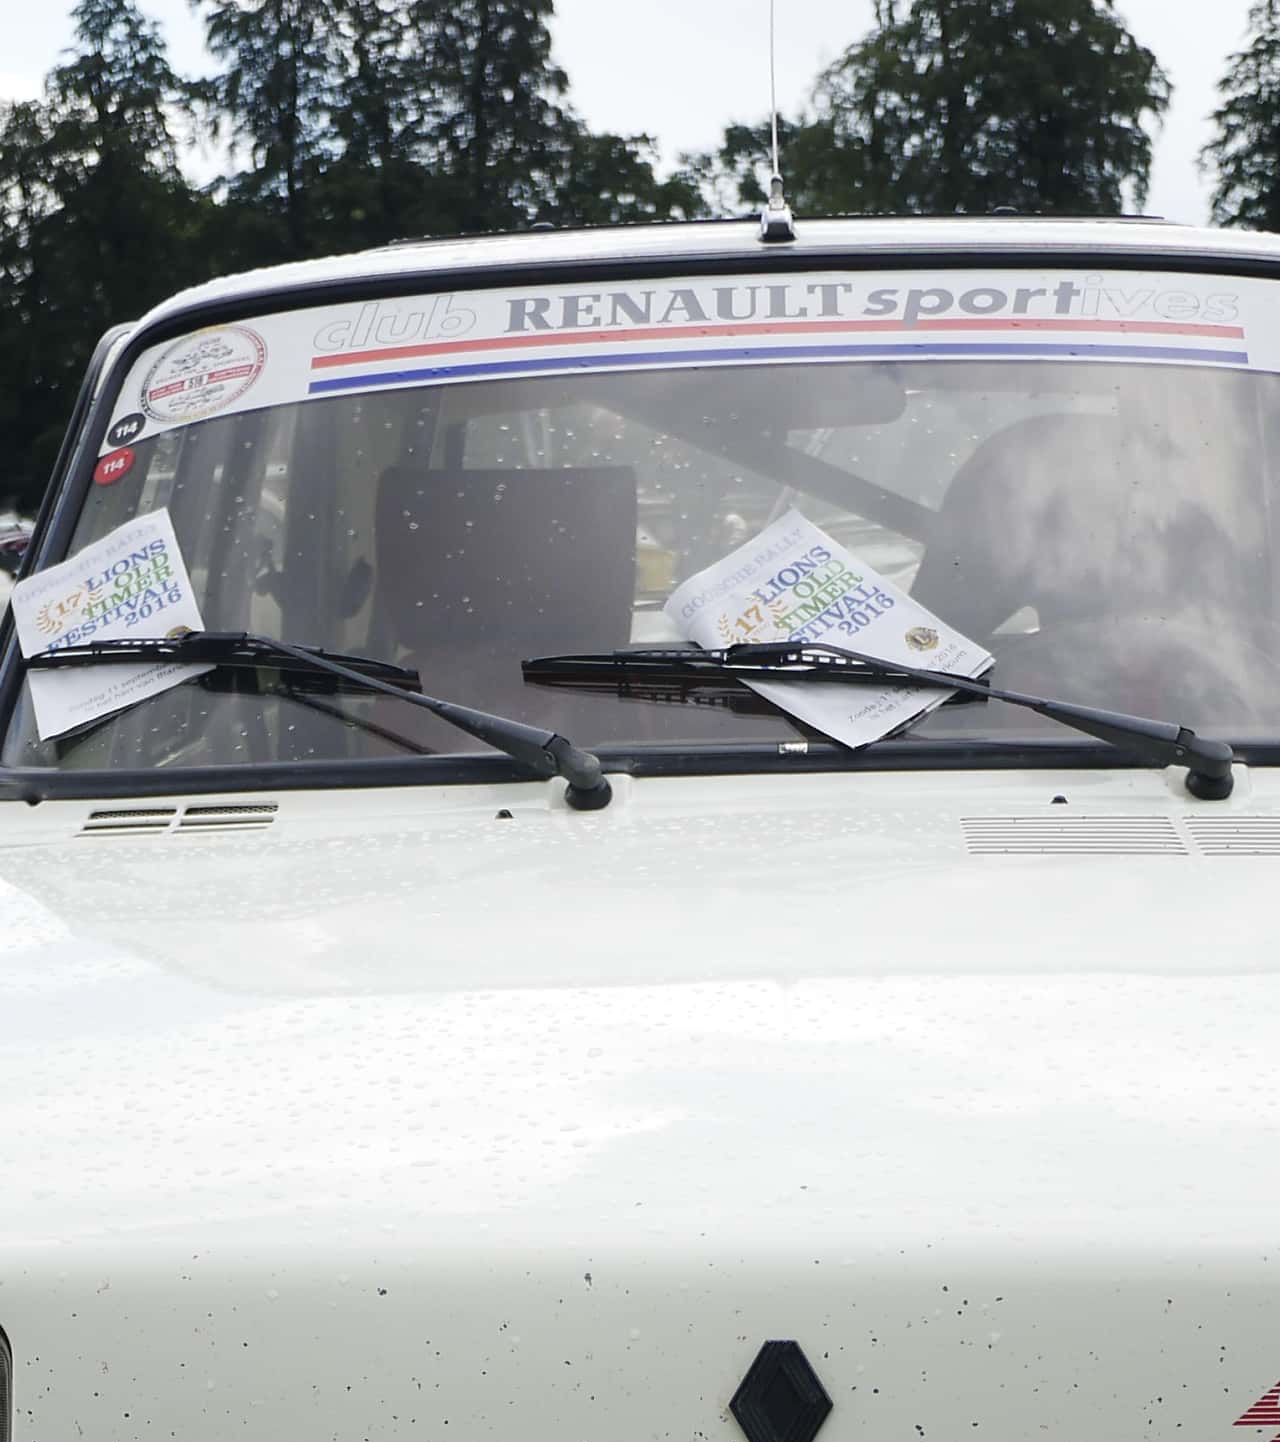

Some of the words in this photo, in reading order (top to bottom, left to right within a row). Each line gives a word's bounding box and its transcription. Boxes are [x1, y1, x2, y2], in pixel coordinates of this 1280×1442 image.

[311, 293, 477, 352] club
[502, 282, 854, 334] RENAULT
[862, 273, 1240, 329] sportives
[115, 421, 140, 439] 114
[102, 457, 125, 475] 114
[84, 538, 166, 593] LIONS
[113, 552, 169, 588] OLD
[751, 545, 832, 606] LIONS
[792, 558, 846, 601] OLD
[56, 591, 83, 615] 17
[81, 566, 175, 620] TIMER
[124, 588, 182, 628] 2016
[774, 569, 865, 634] TIMER
[735, 604, 764, 635] 17
[838, 592, 896, 638] 2016
